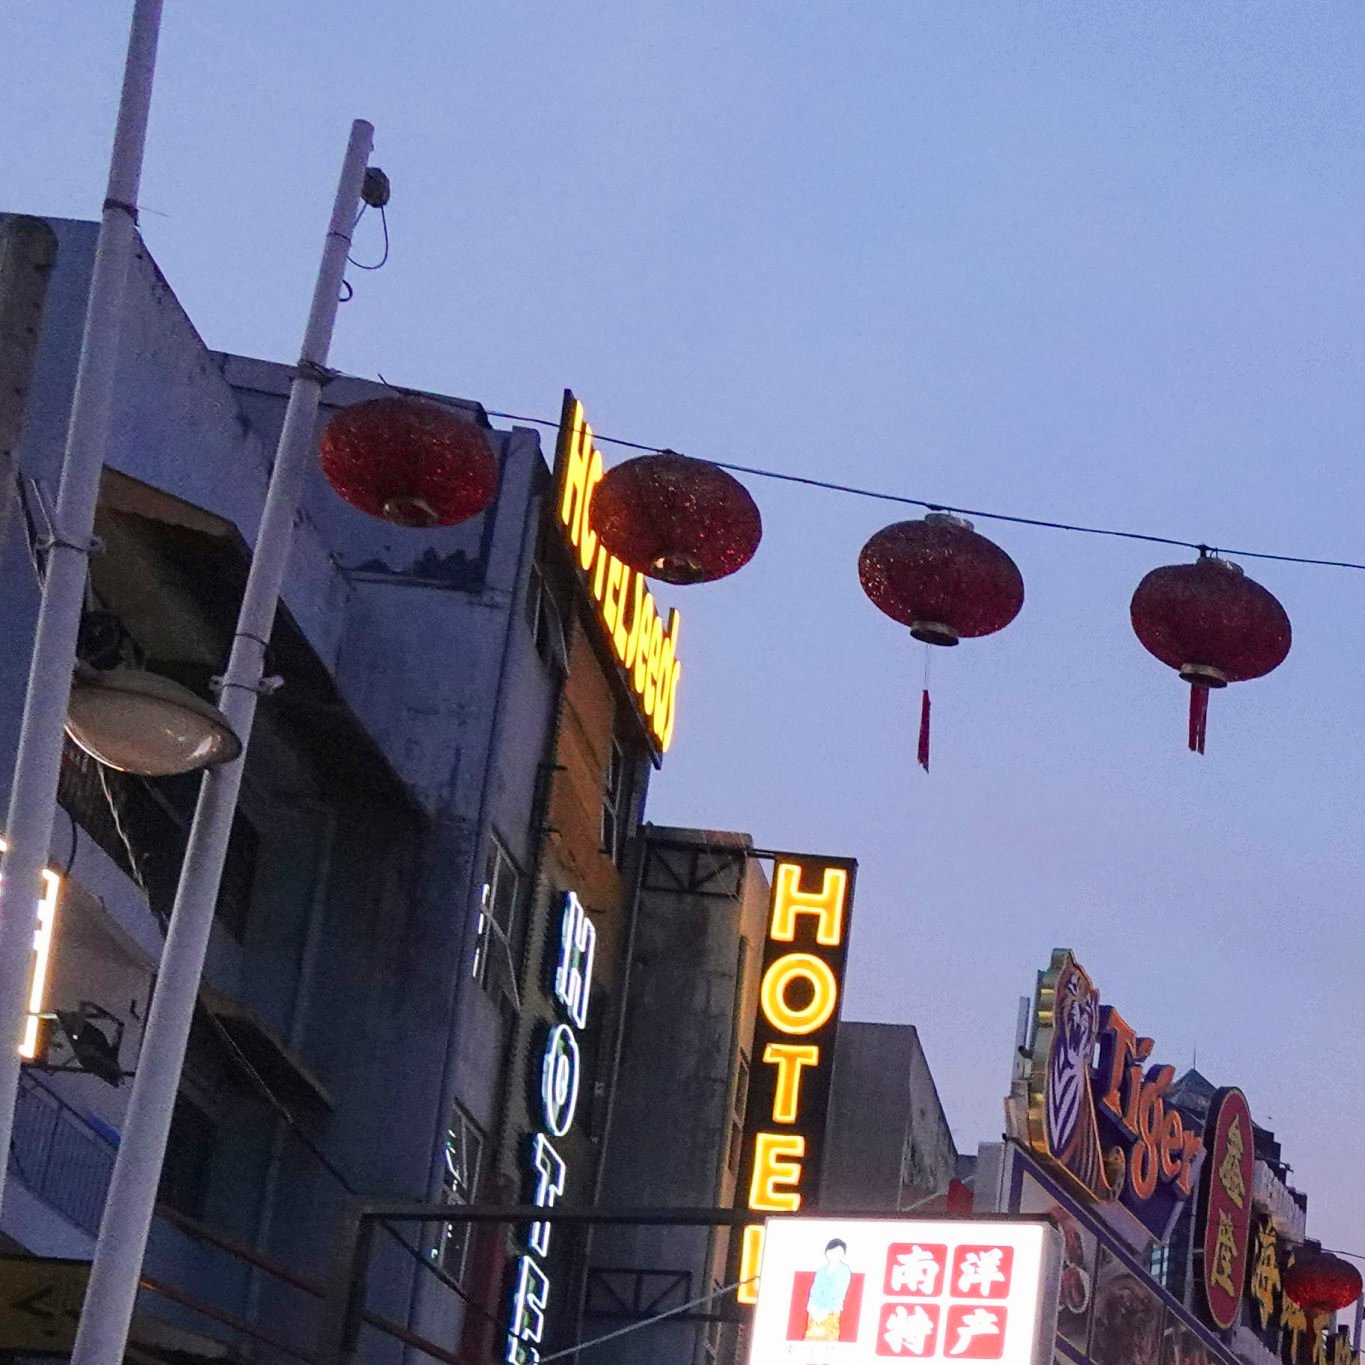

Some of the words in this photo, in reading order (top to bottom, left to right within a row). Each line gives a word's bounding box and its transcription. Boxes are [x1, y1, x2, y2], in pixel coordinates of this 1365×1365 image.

[738, 864, 847, 1305] HOTEL
[1101, 1006, 1206, 1201] Tiger
[882, 1303, 1001, 1356] 特产
[889, 1244, 1006, 1297] 南洋
